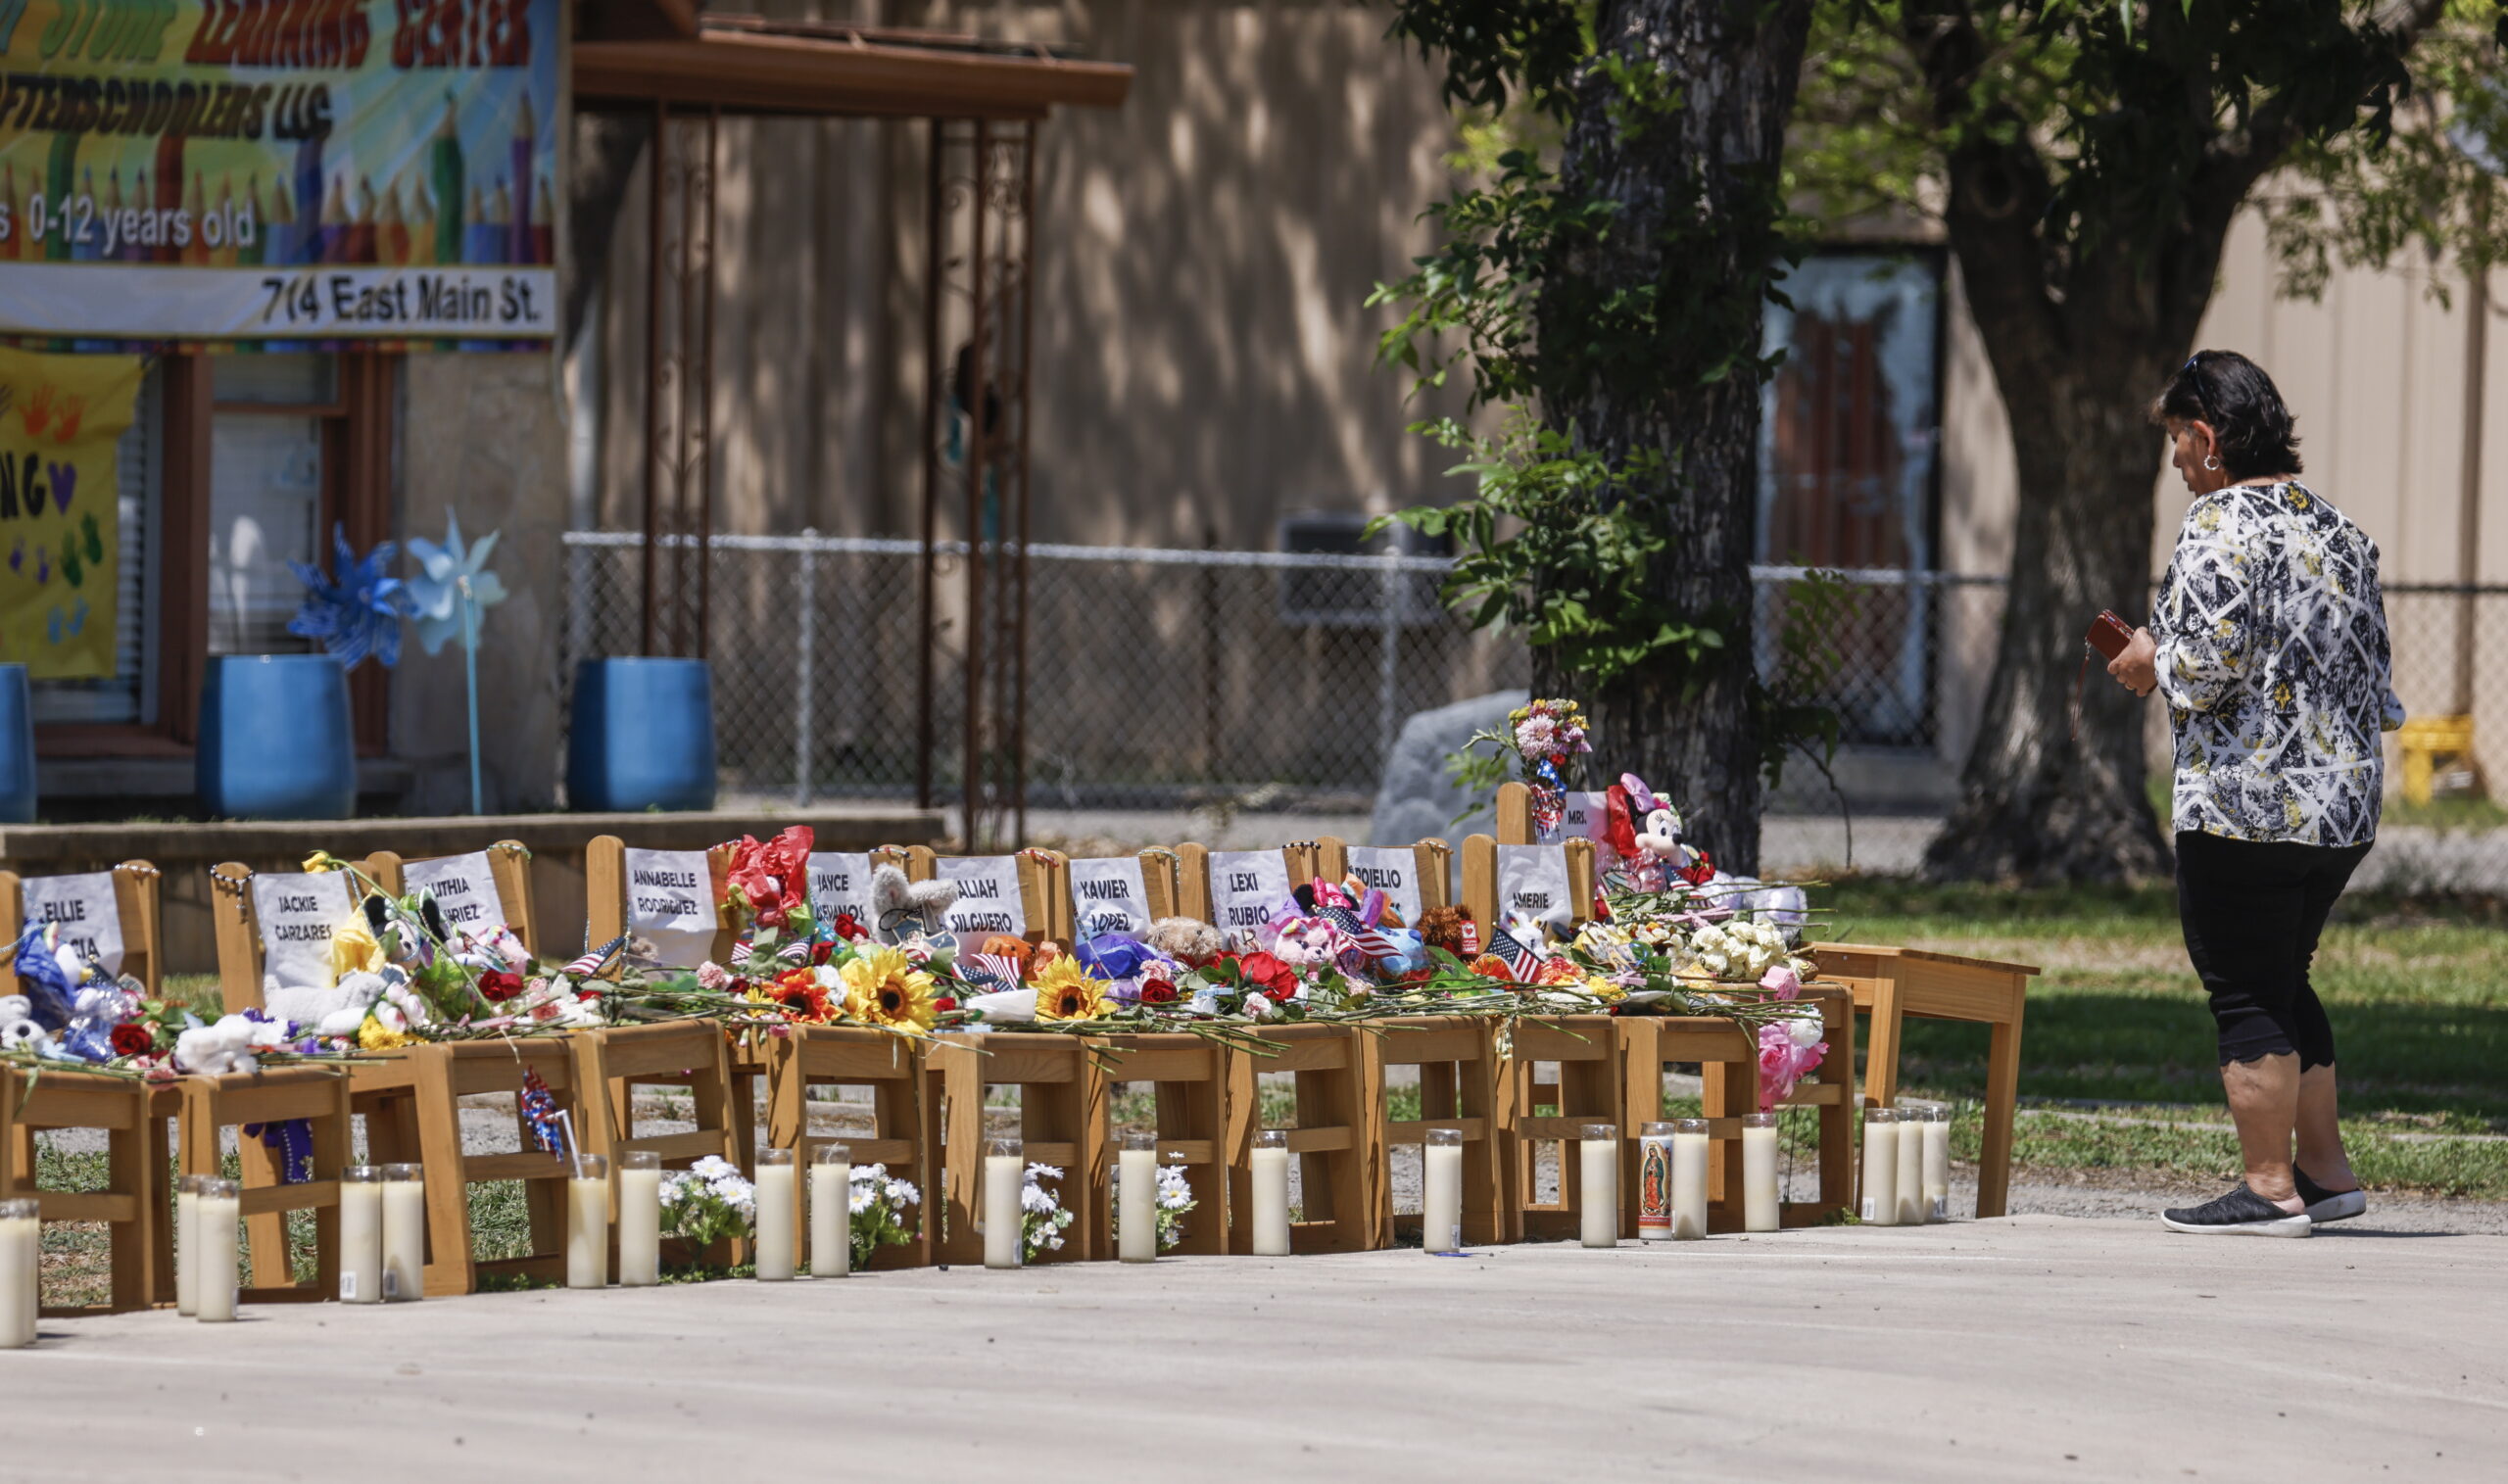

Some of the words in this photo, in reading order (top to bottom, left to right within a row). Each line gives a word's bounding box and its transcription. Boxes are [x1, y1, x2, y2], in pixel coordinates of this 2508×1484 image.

[0, 72, 276, 139] FTERSCHOOLERS
[28, 192, 94, 243] 0-12
[102, 208, 192, 257] years
[202, 198, 257, 246] old
[261, 276, 320, 322] 714
[330, 275, 409, 321] East
[416, 273, 491, 321] Main
[498, 274, 542, 322] St.
[1568, 809, 1588, 825] MRS.
[425, 877, 471, 898] LITHIA
[633, 869, 698, 888] ANNABELLE
[817, 874, 849, 892] JAYCE
[1230, 872, 1259, 892] LEXI
[1080, 879, 1131, 900] XAVIER
[277, 895, 318, 913] JACKIE
[637, 896, 699, 916] RODRIGUEZ
[1513, 892, 1550, 909] AMERIE
[38, 899, 86, 924] ELLIE
[813, 903, 865, 923] UEVANOS
[1228, 905, 1271, 927] RUBIO
[1090, 912, 1131, 933] LOPEZ
